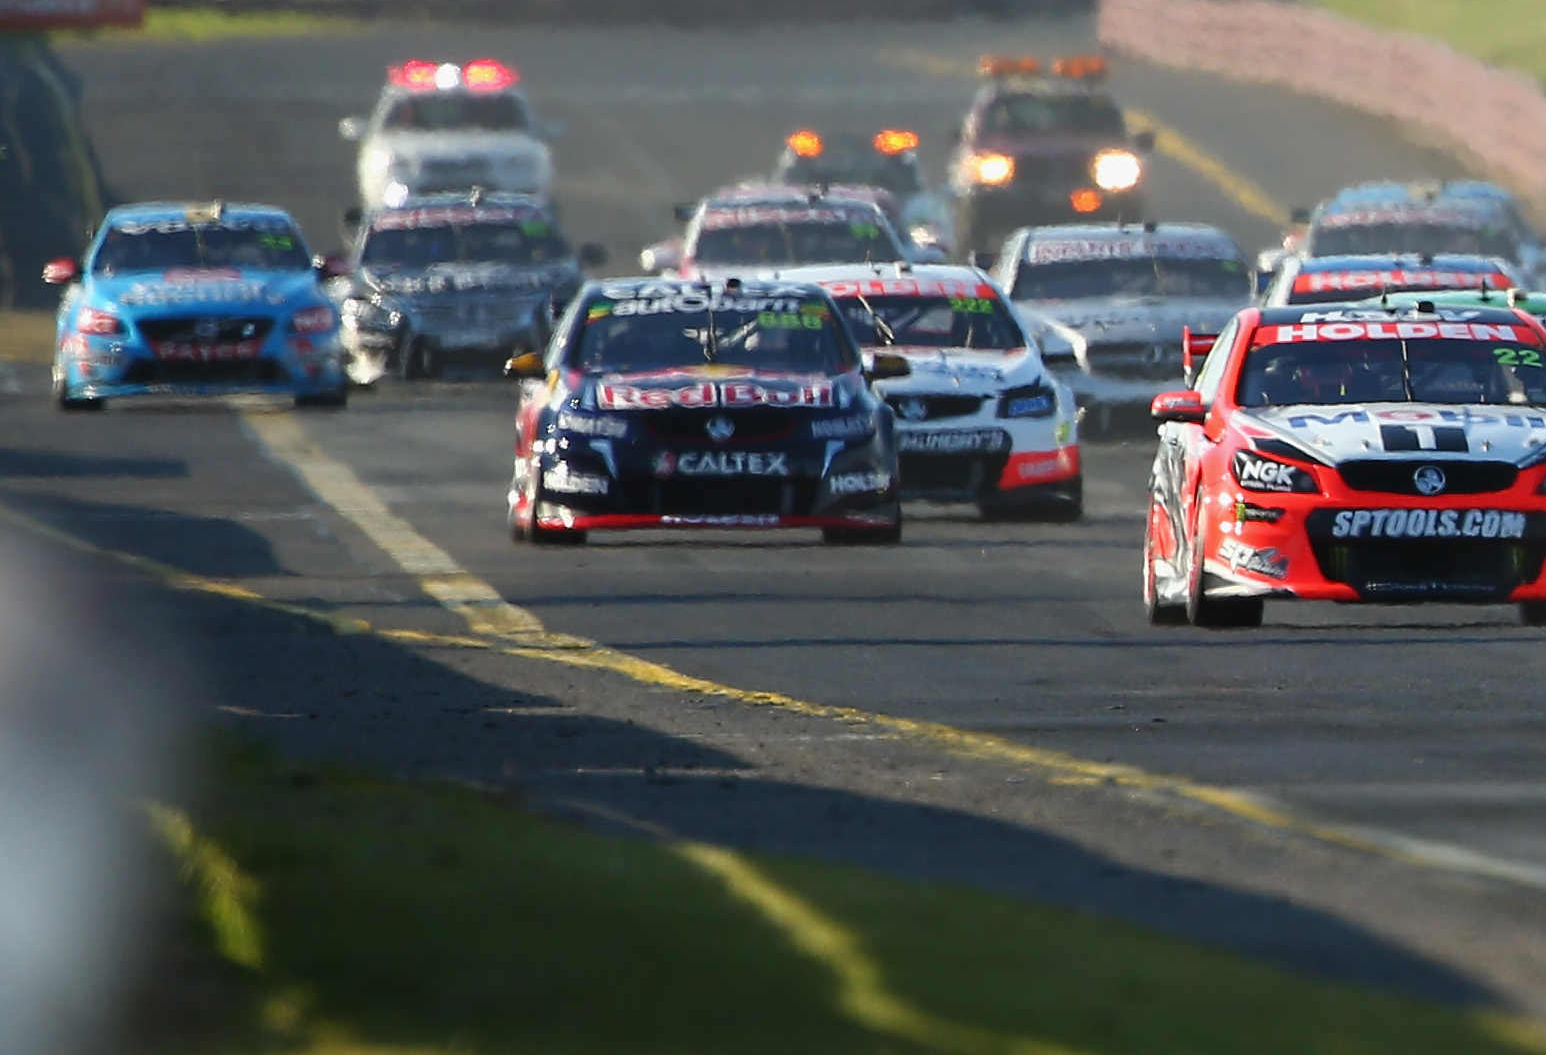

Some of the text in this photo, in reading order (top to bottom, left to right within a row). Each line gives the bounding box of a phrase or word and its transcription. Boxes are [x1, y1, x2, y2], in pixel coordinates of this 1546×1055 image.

[1277, 322, 1518, 343] HOLDEN
[1494, 347, 1543, 368] 22
[597, 381, 717, 410] Red
[678, 451, 789, 476] CALTEX
[1242, 459, 1297, 486] NGK
[1332, 509, 1527, 538] SPTOOLS.COM
